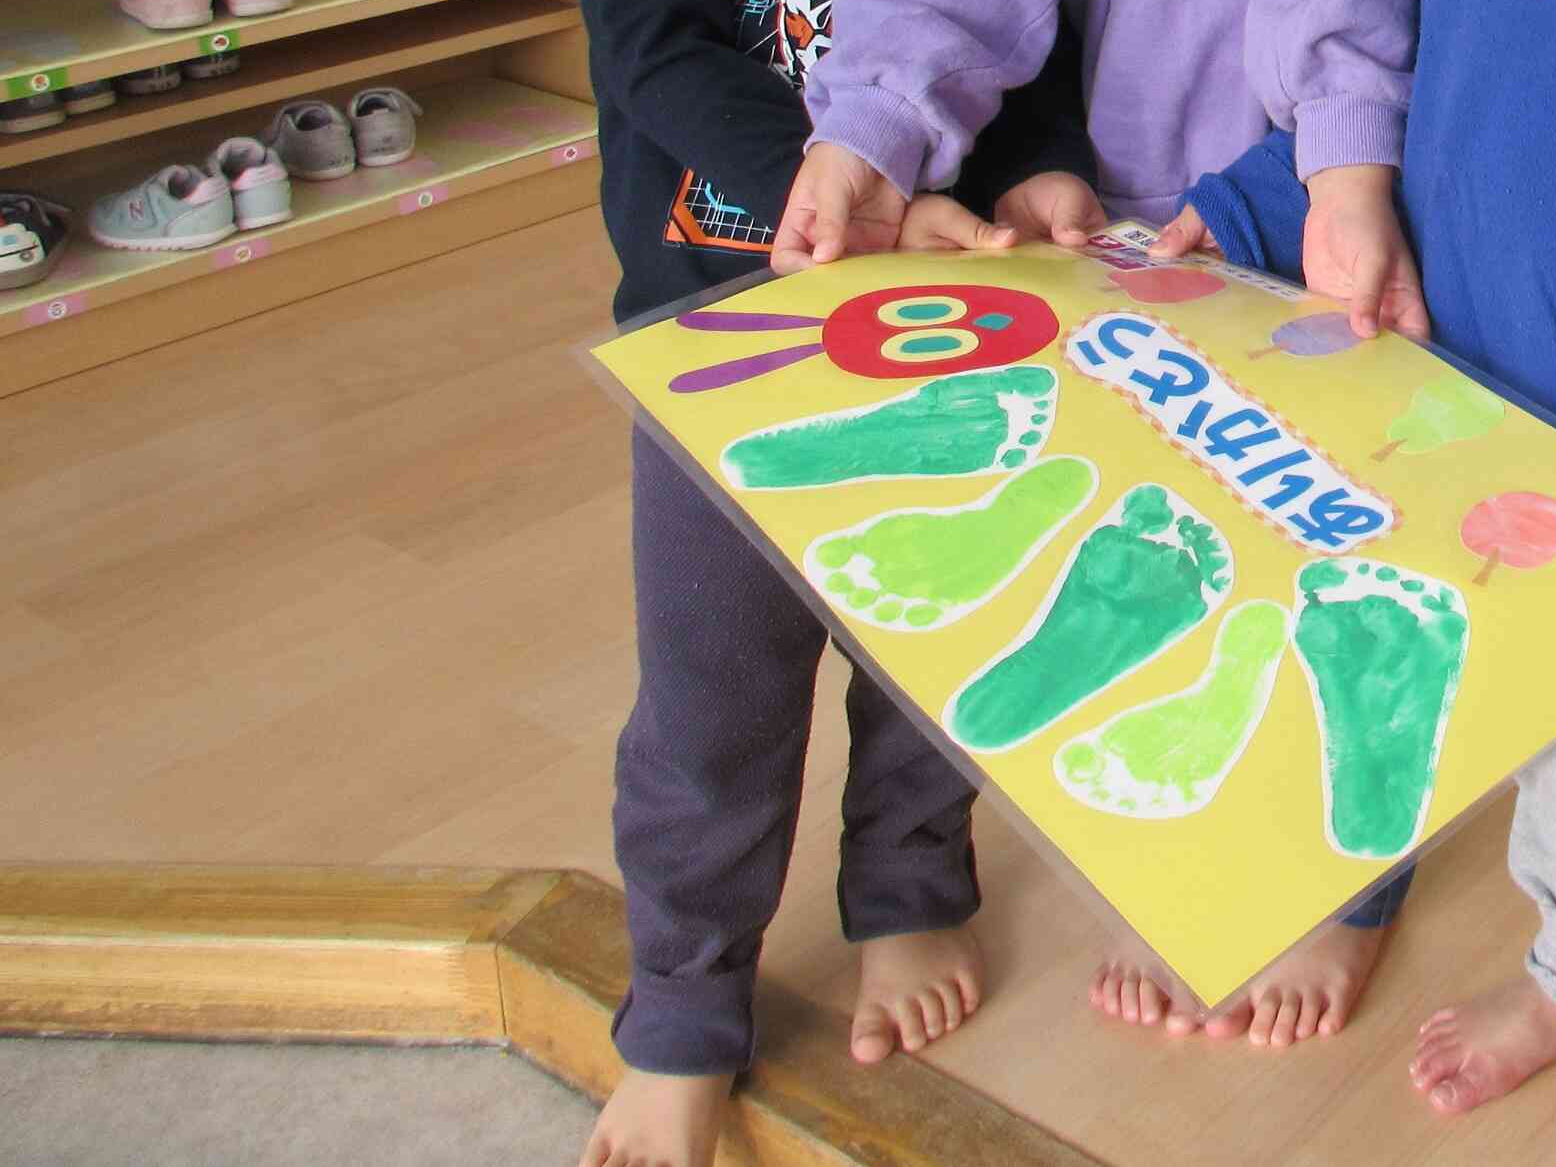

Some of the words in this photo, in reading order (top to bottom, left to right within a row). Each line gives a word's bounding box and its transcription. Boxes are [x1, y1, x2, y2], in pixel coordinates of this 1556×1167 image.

[1077, 317, 1385, 547] ありがとう
